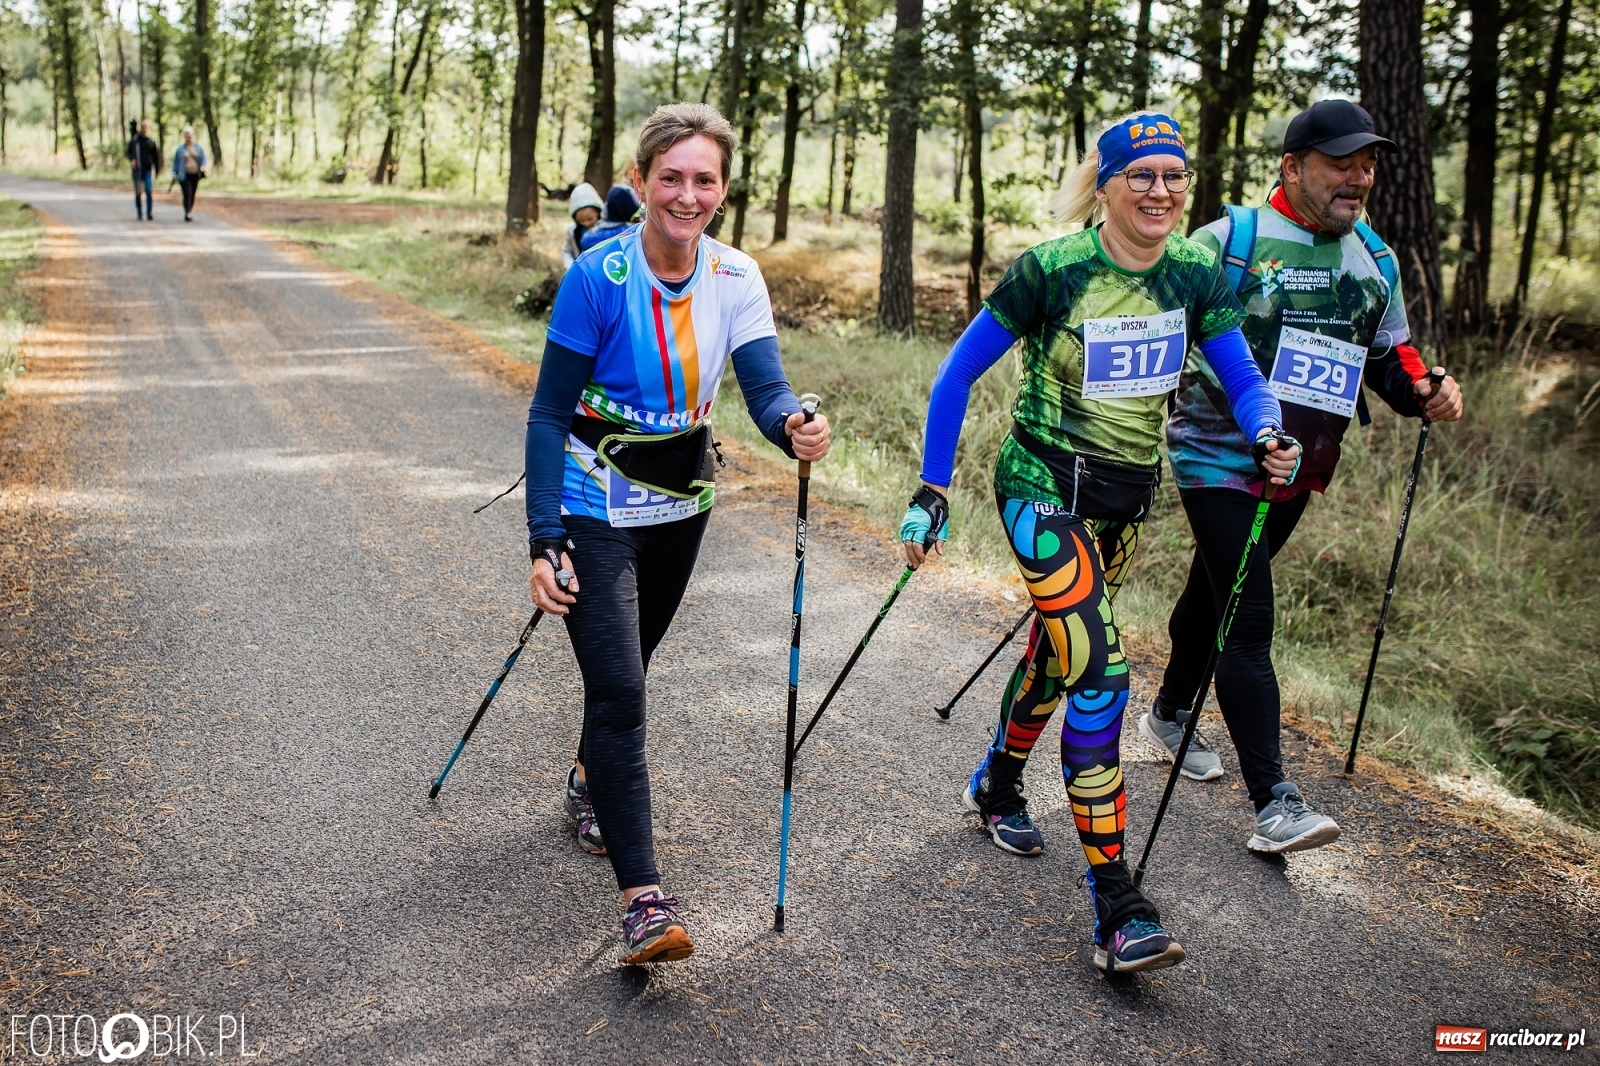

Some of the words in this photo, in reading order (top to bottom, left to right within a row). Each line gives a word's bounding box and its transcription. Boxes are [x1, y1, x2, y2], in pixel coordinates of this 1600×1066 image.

[1284, 283, 1316, 291] RAFAMET
[1121, 321, 1148, 331] DYSZKA
[1309, 336, 1332, 349] DYSZKA
[1109, 340, 1169, 378] 317
[1287, 353, 1347, 395] 329
